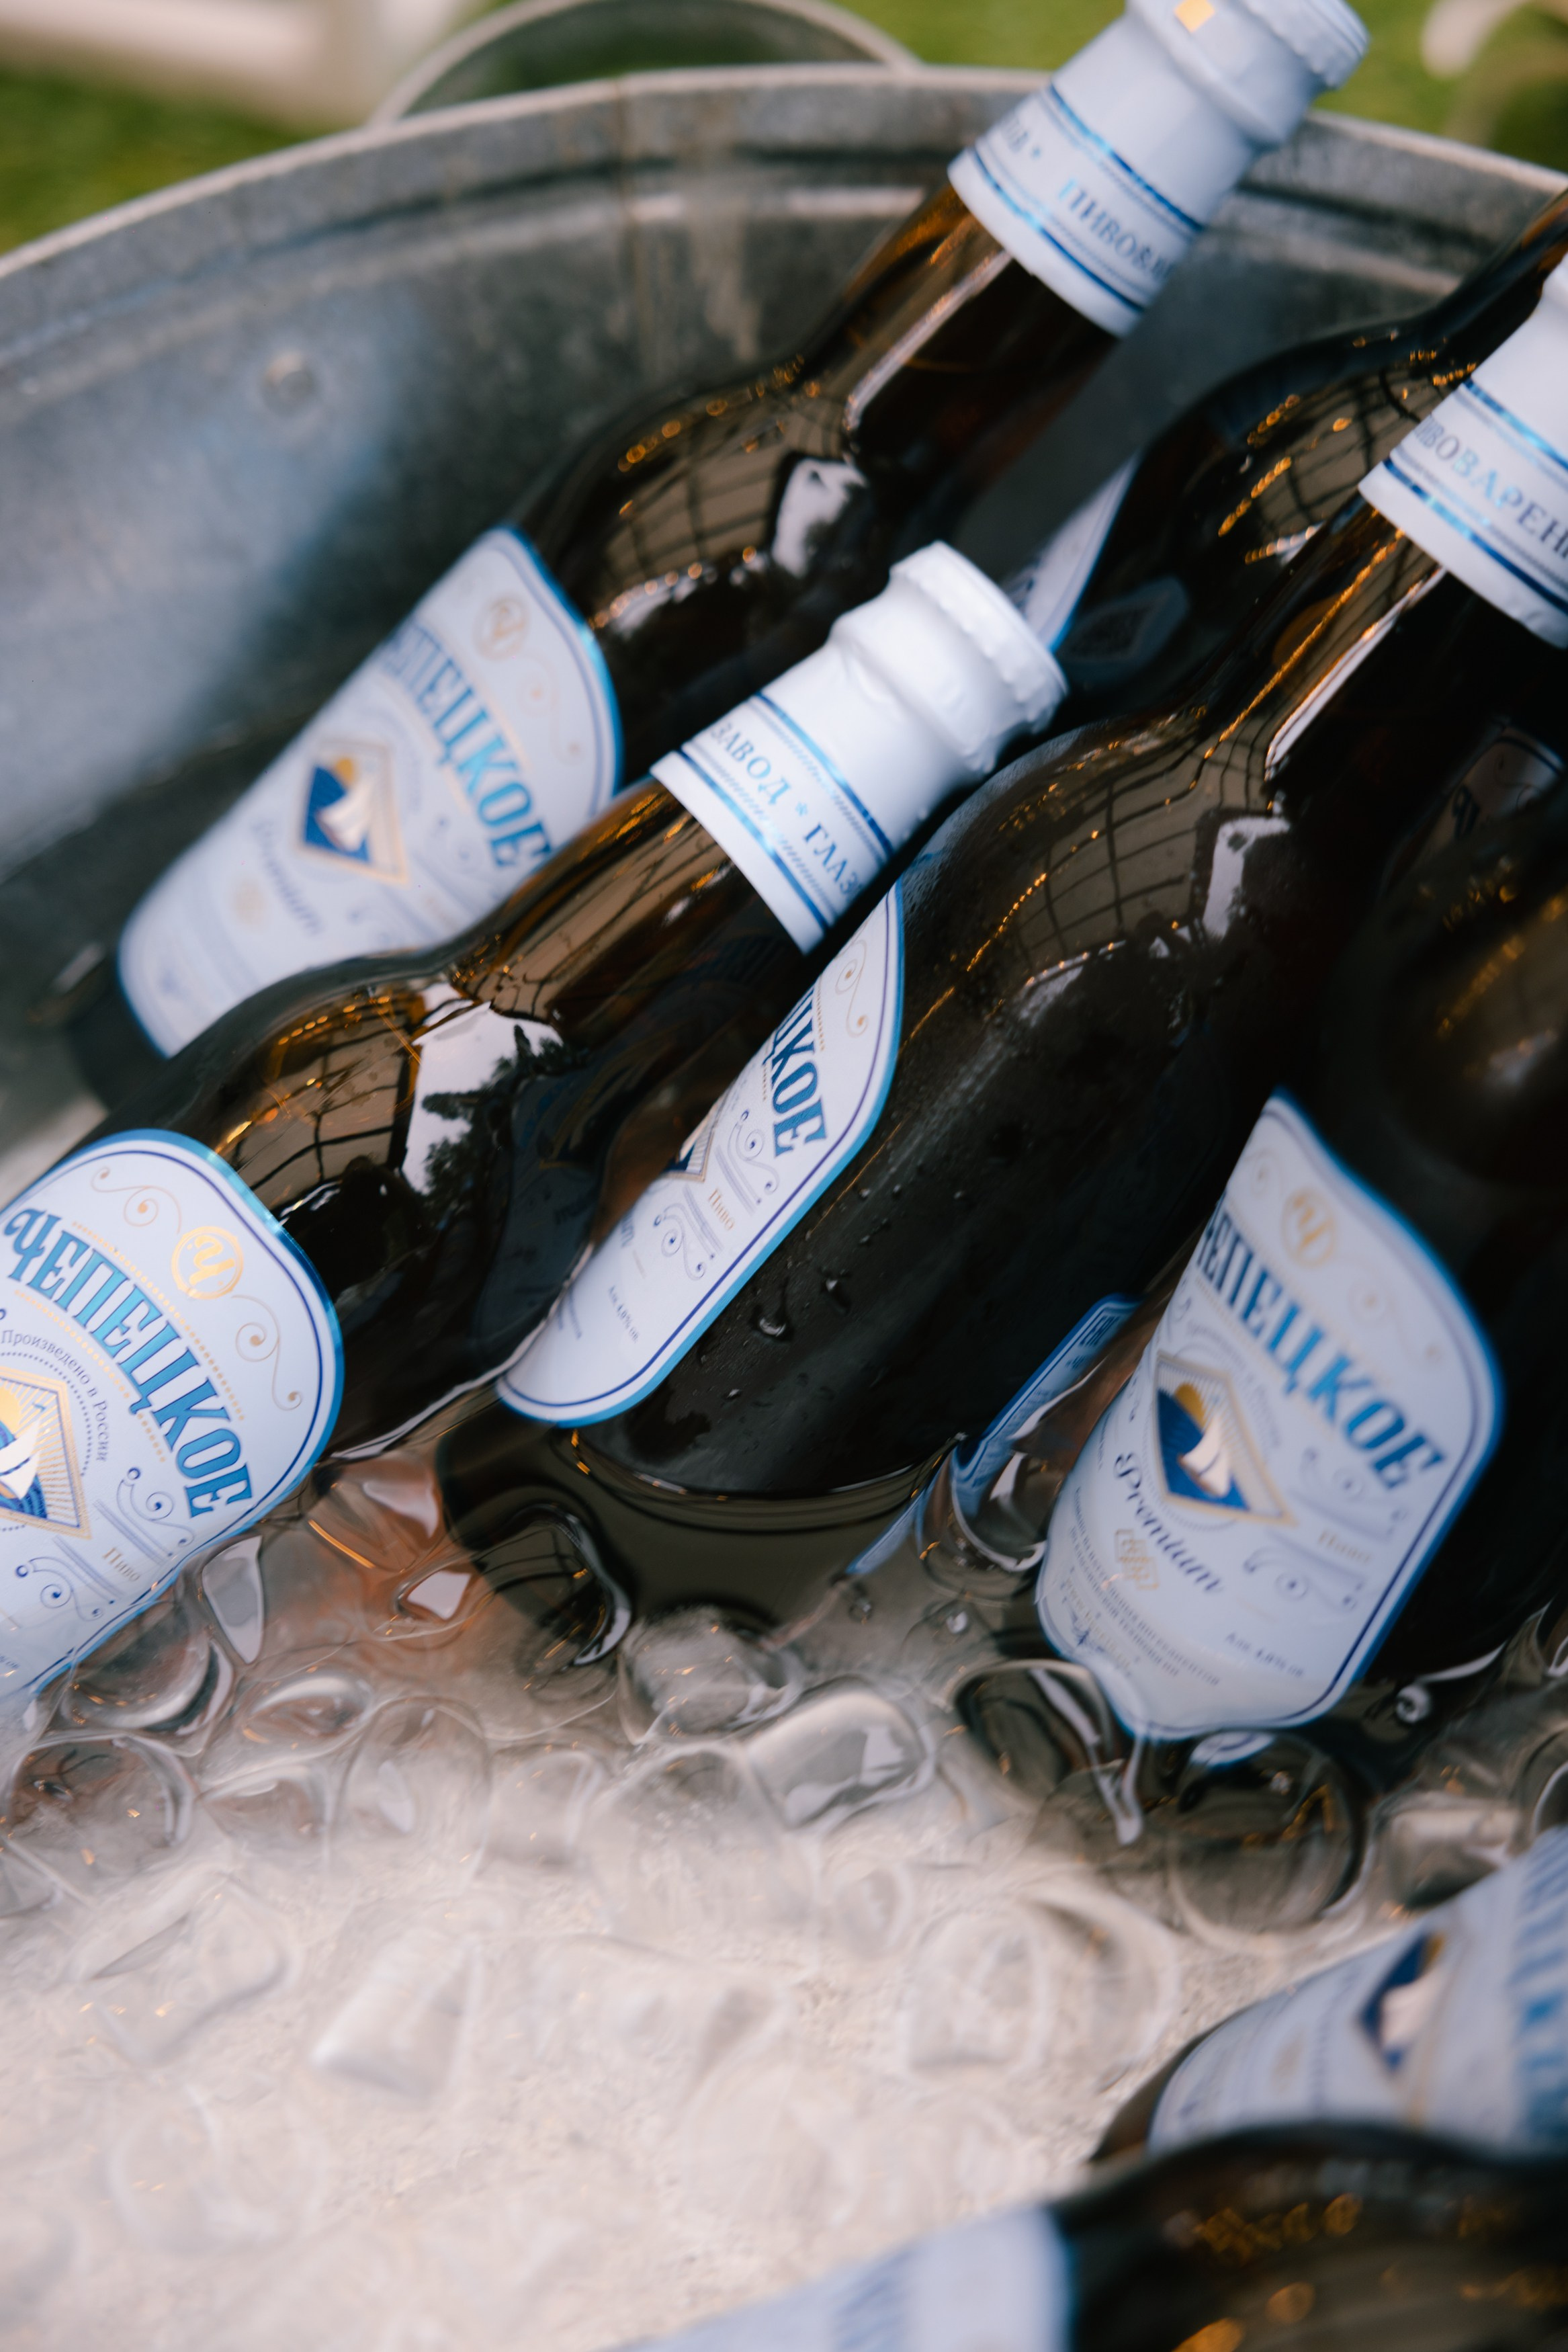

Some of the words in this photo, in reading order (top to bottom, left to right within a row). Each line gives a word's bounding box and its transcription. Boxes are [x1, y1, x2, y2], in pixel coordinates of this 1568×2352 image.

[711, 722, 791, 806] ЗАВОД
[707, 1187, 735, 1231] Пиво
[1, 1329, 91, 1386] Произведено
[87, 1386, 98, 1397] в
[93, 1400, 110, 1463] России
[3, 1207, 253, 1519] ЧЕПЕЦКОЕ
[102, 1546, 142, 1582] Пиво
[1113, 1451, 1224, 1594] Premium
